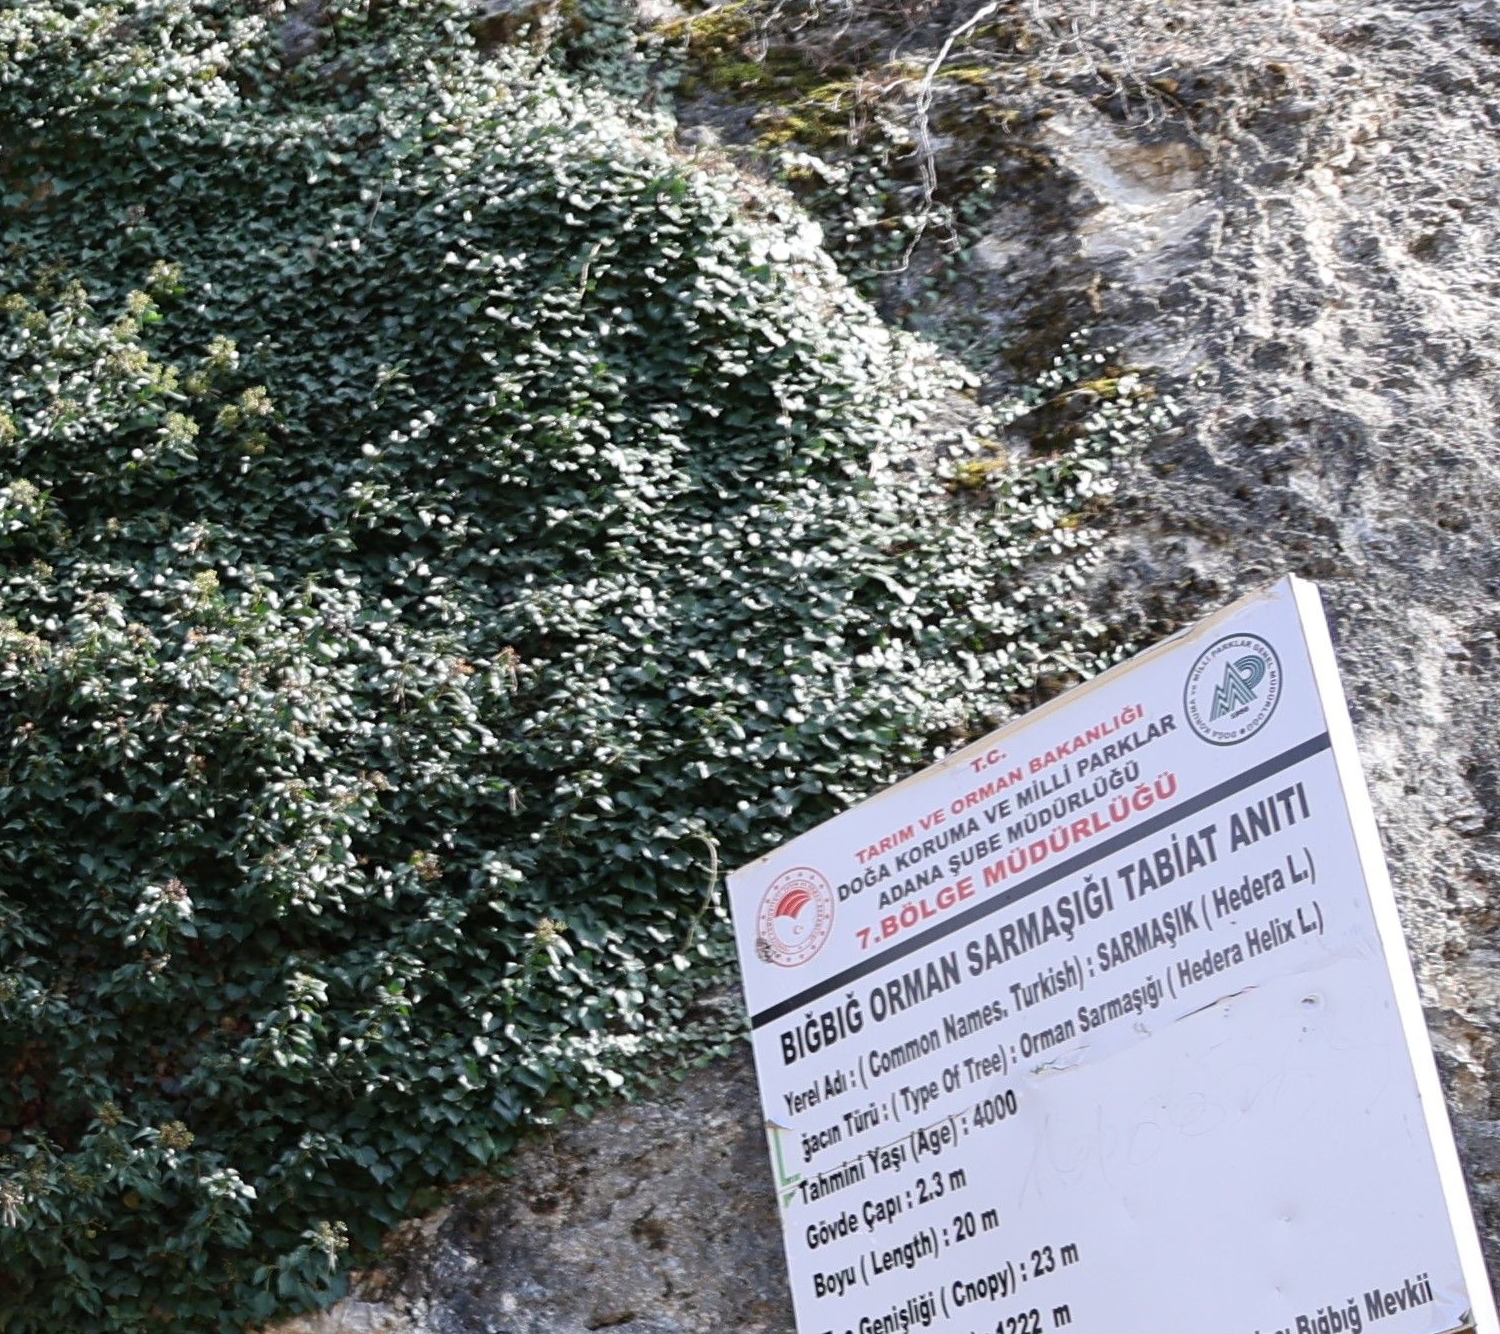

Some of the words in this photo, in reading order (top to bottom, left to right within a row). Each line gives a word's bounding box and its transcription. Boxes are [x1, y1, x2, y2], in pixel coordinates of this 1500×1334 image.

[838, 864, 891, 902] DOĞA
[894, 817, 981, 872] KORUMA
[985, 799, 1011, 825] VE
[1016, 763, 1072, 808] MİLLİ
[1077, 714, 1178, 779] PARKLAR
[855, 825, 915, 865] TARIM
[918, 807, 946, 831] VE
[950, 768, 1024, 816] ORMAN
[1029, 703, 1144, 774] BAKANLIĞI
[970, 748, 1007, 774] T.C.
[855, 875, 976, 951] 7.BÖLGE
[982, 771, 1179, 888] MÜDÜRLÜĞÜ
[878, 864, 943, 910] ADANA
[949, 832, 1002, 878] ŞUBE
[1007, 760, 1141, 841] MÜDÜRLÜĞÜ
[779, 991, 864, 1066] BIĞBIĞ
[869, 951, 961, 1023] ORMAN
[965, 874, 1115, 977] SARMAŞIĞI
[1117, 823, 1218, 902] TABİAT
[1229, 781, 1311, 854] ANITI
[783, 1084, 820, 1117] Yerel
[823, 1068, 848, 1098] Adı
[868, 1029, 942, 1079] Common
[1009, 955, 1084, 1010] Turkish)
[1096, 900, 1199, 972] SARMAŞIK
[1212, 871, 1286, 918] Hedera
[1286, 846, 1317, 885] L.)
[843, 1100, 880, 1137] Türü
[900, 1078, 940, 1115] Type
[942, 1063, 960, 1094] Of
[965, 1043, 1008, 1083] Tree)
[1020, 1020, 1075, 1059] Orman
[1077, 975, 1163, 1032] Sarmaşığı
[1177, 936, 1243, 989] Hedera
[1245, 914, 1295, 958] Helix
[1297, 900, 1324, 936] L.)
[799, 1154, 866, 1205] Tahmini
[868, 1145, 906, 1172] Yaşı
[910, 1117, 959, 1163] (Age)
[973, 1089, 1019, 1129] 4000
[805, 1212, 859, 1250] Gövde
[862, 1195, 903, 1232] Çapı
[916, 1171, 945, 1205] 2.3
[949, 1168, 967, 1188] m
[812, 1266, 856, 1299] Boyu
[870, 1227, 939, 1276] Length)
[953, 1211, 976, 1243] 20
[981, 1208, 1000, 1229] m
[952, 1261, 1016, 1307] Cnopy)
[1030, 1246, 1056, 1278] 23
[1060, 1242, 1079, 1266] m
[1052, 1303, 1072, 1328] m
[1363, 1272, 1434, 1322] Mevkii
